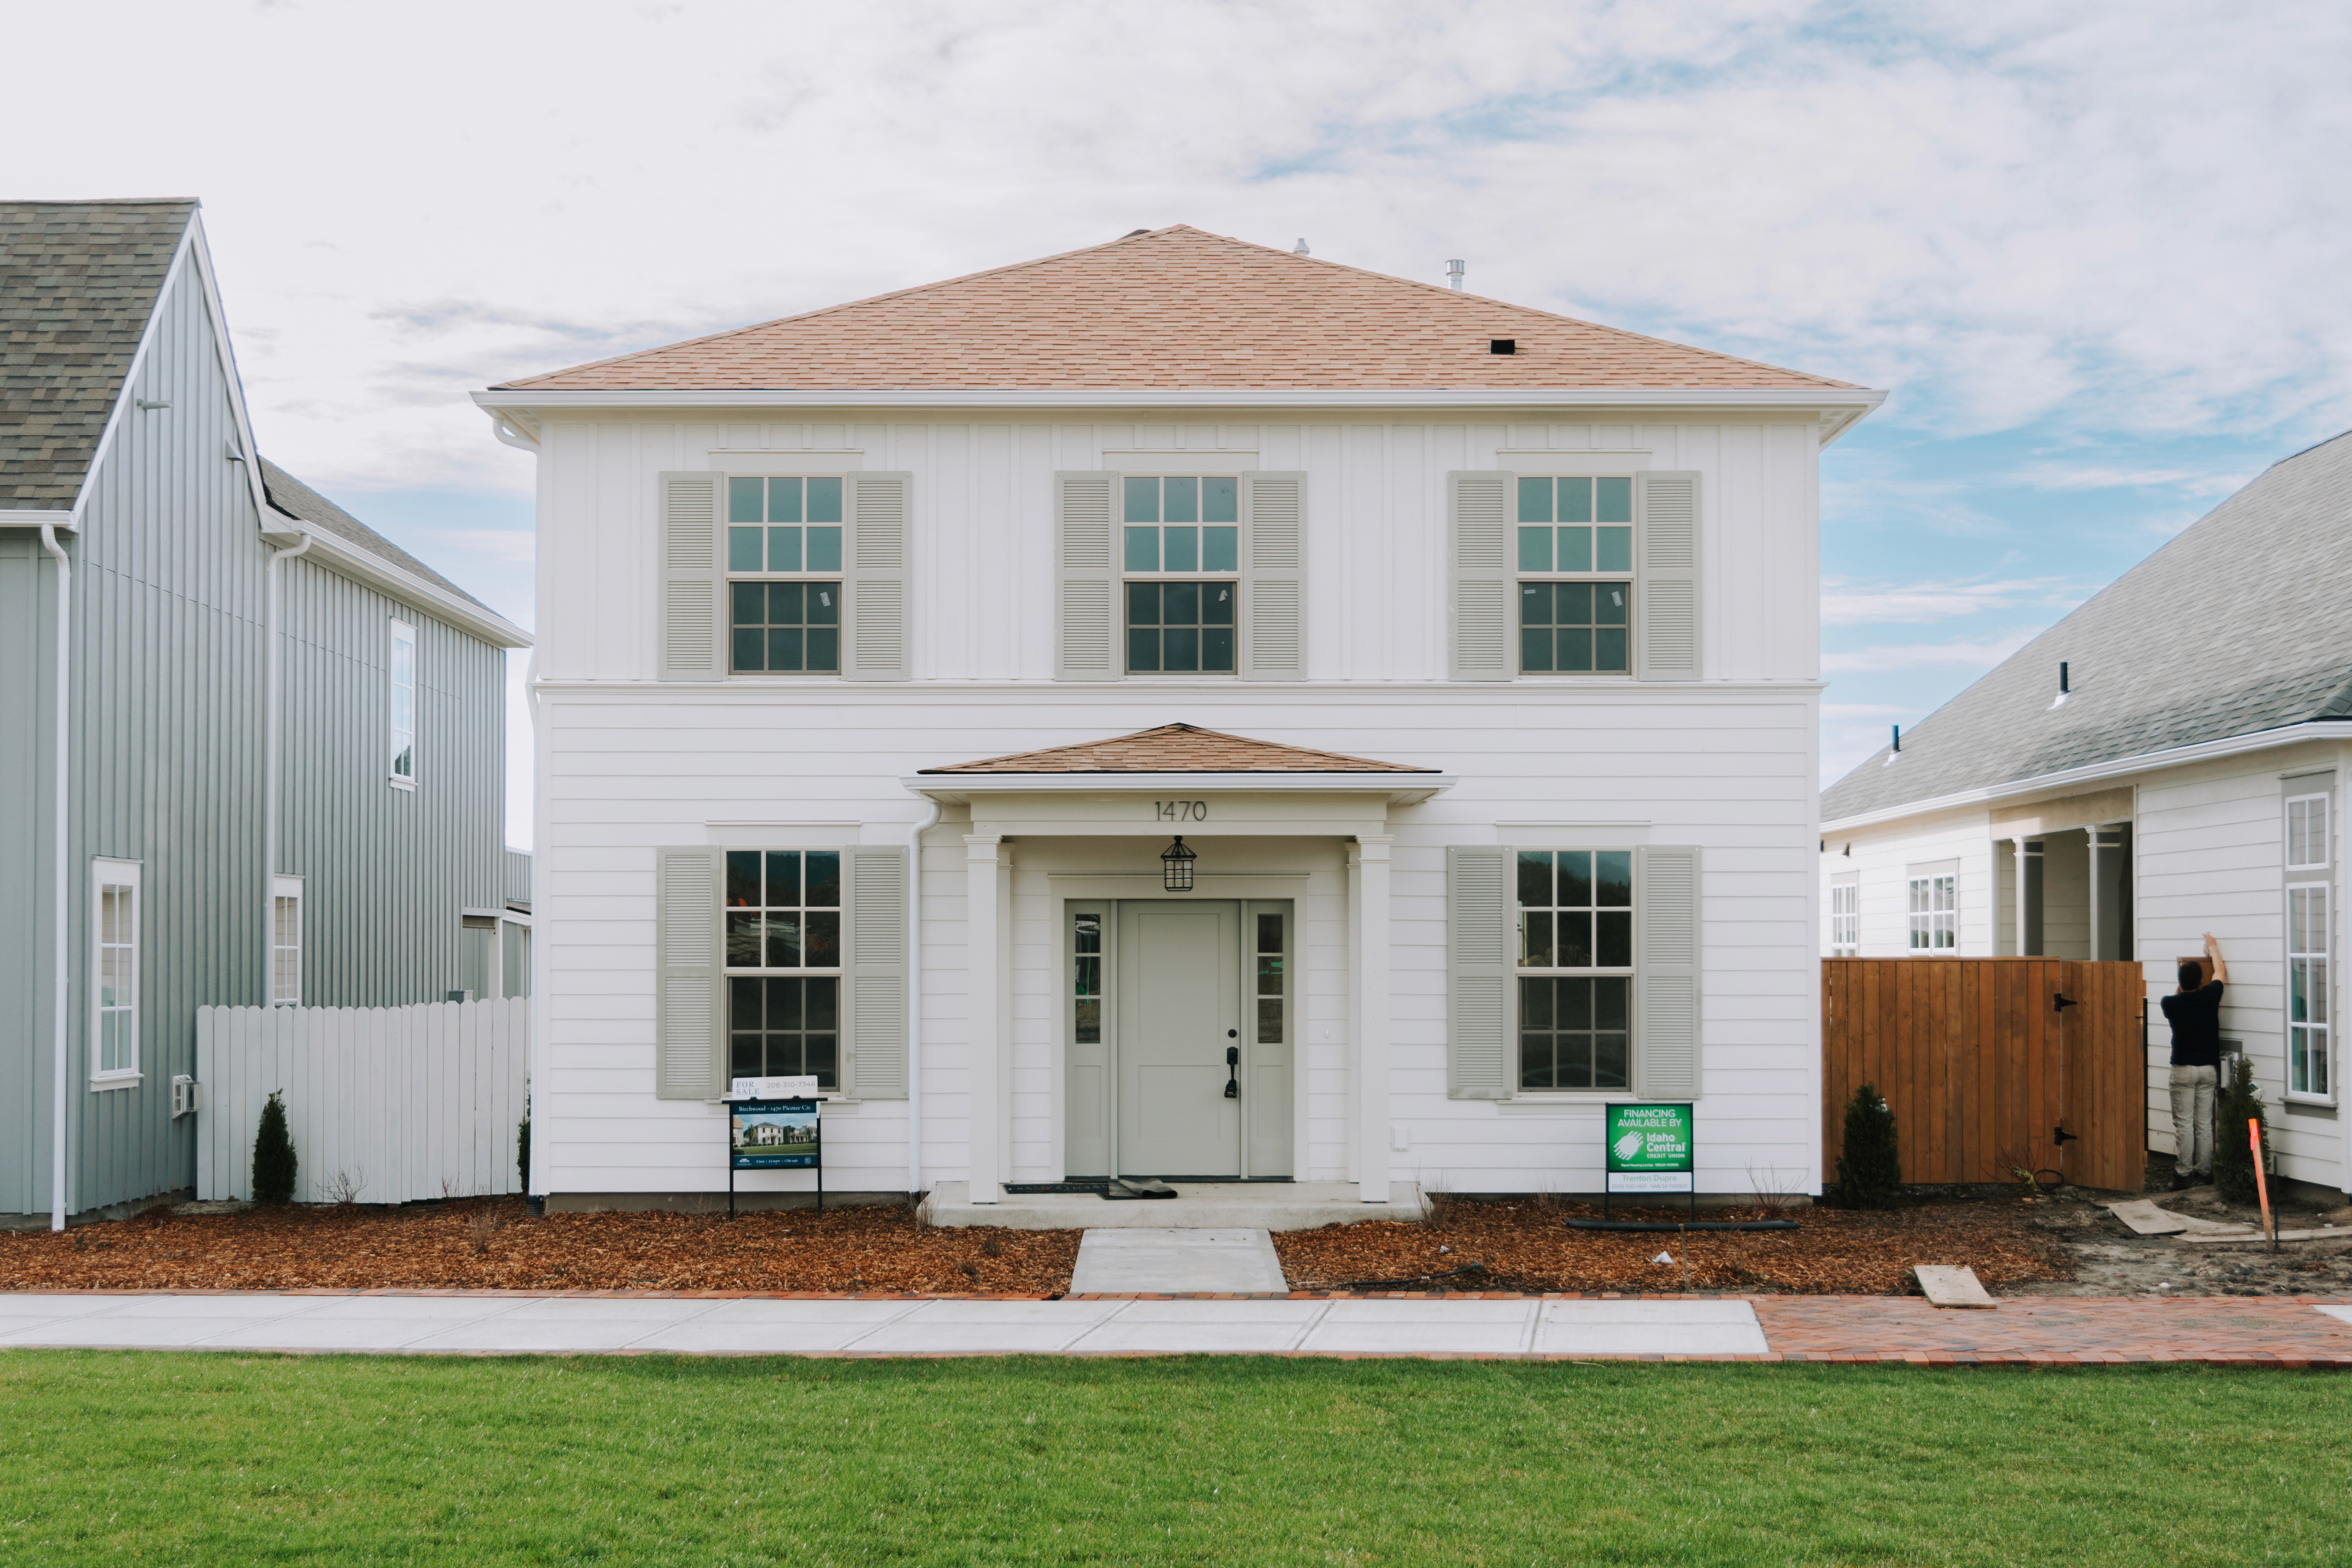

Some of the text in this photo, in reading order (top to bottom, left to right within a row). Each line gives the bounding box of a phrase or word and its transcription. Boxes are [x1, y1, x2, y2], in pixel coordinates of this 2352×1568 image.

[1155, 801, 1206, 821] 1470
[1624, 1109, 1676, 1117] FINANCING
[1617, 1118, 1682, 1127] AVAILABLE BY
[1647, 1132, 1675, 1142] Idaho
[1647, 1142, 1685, 1152] Central
